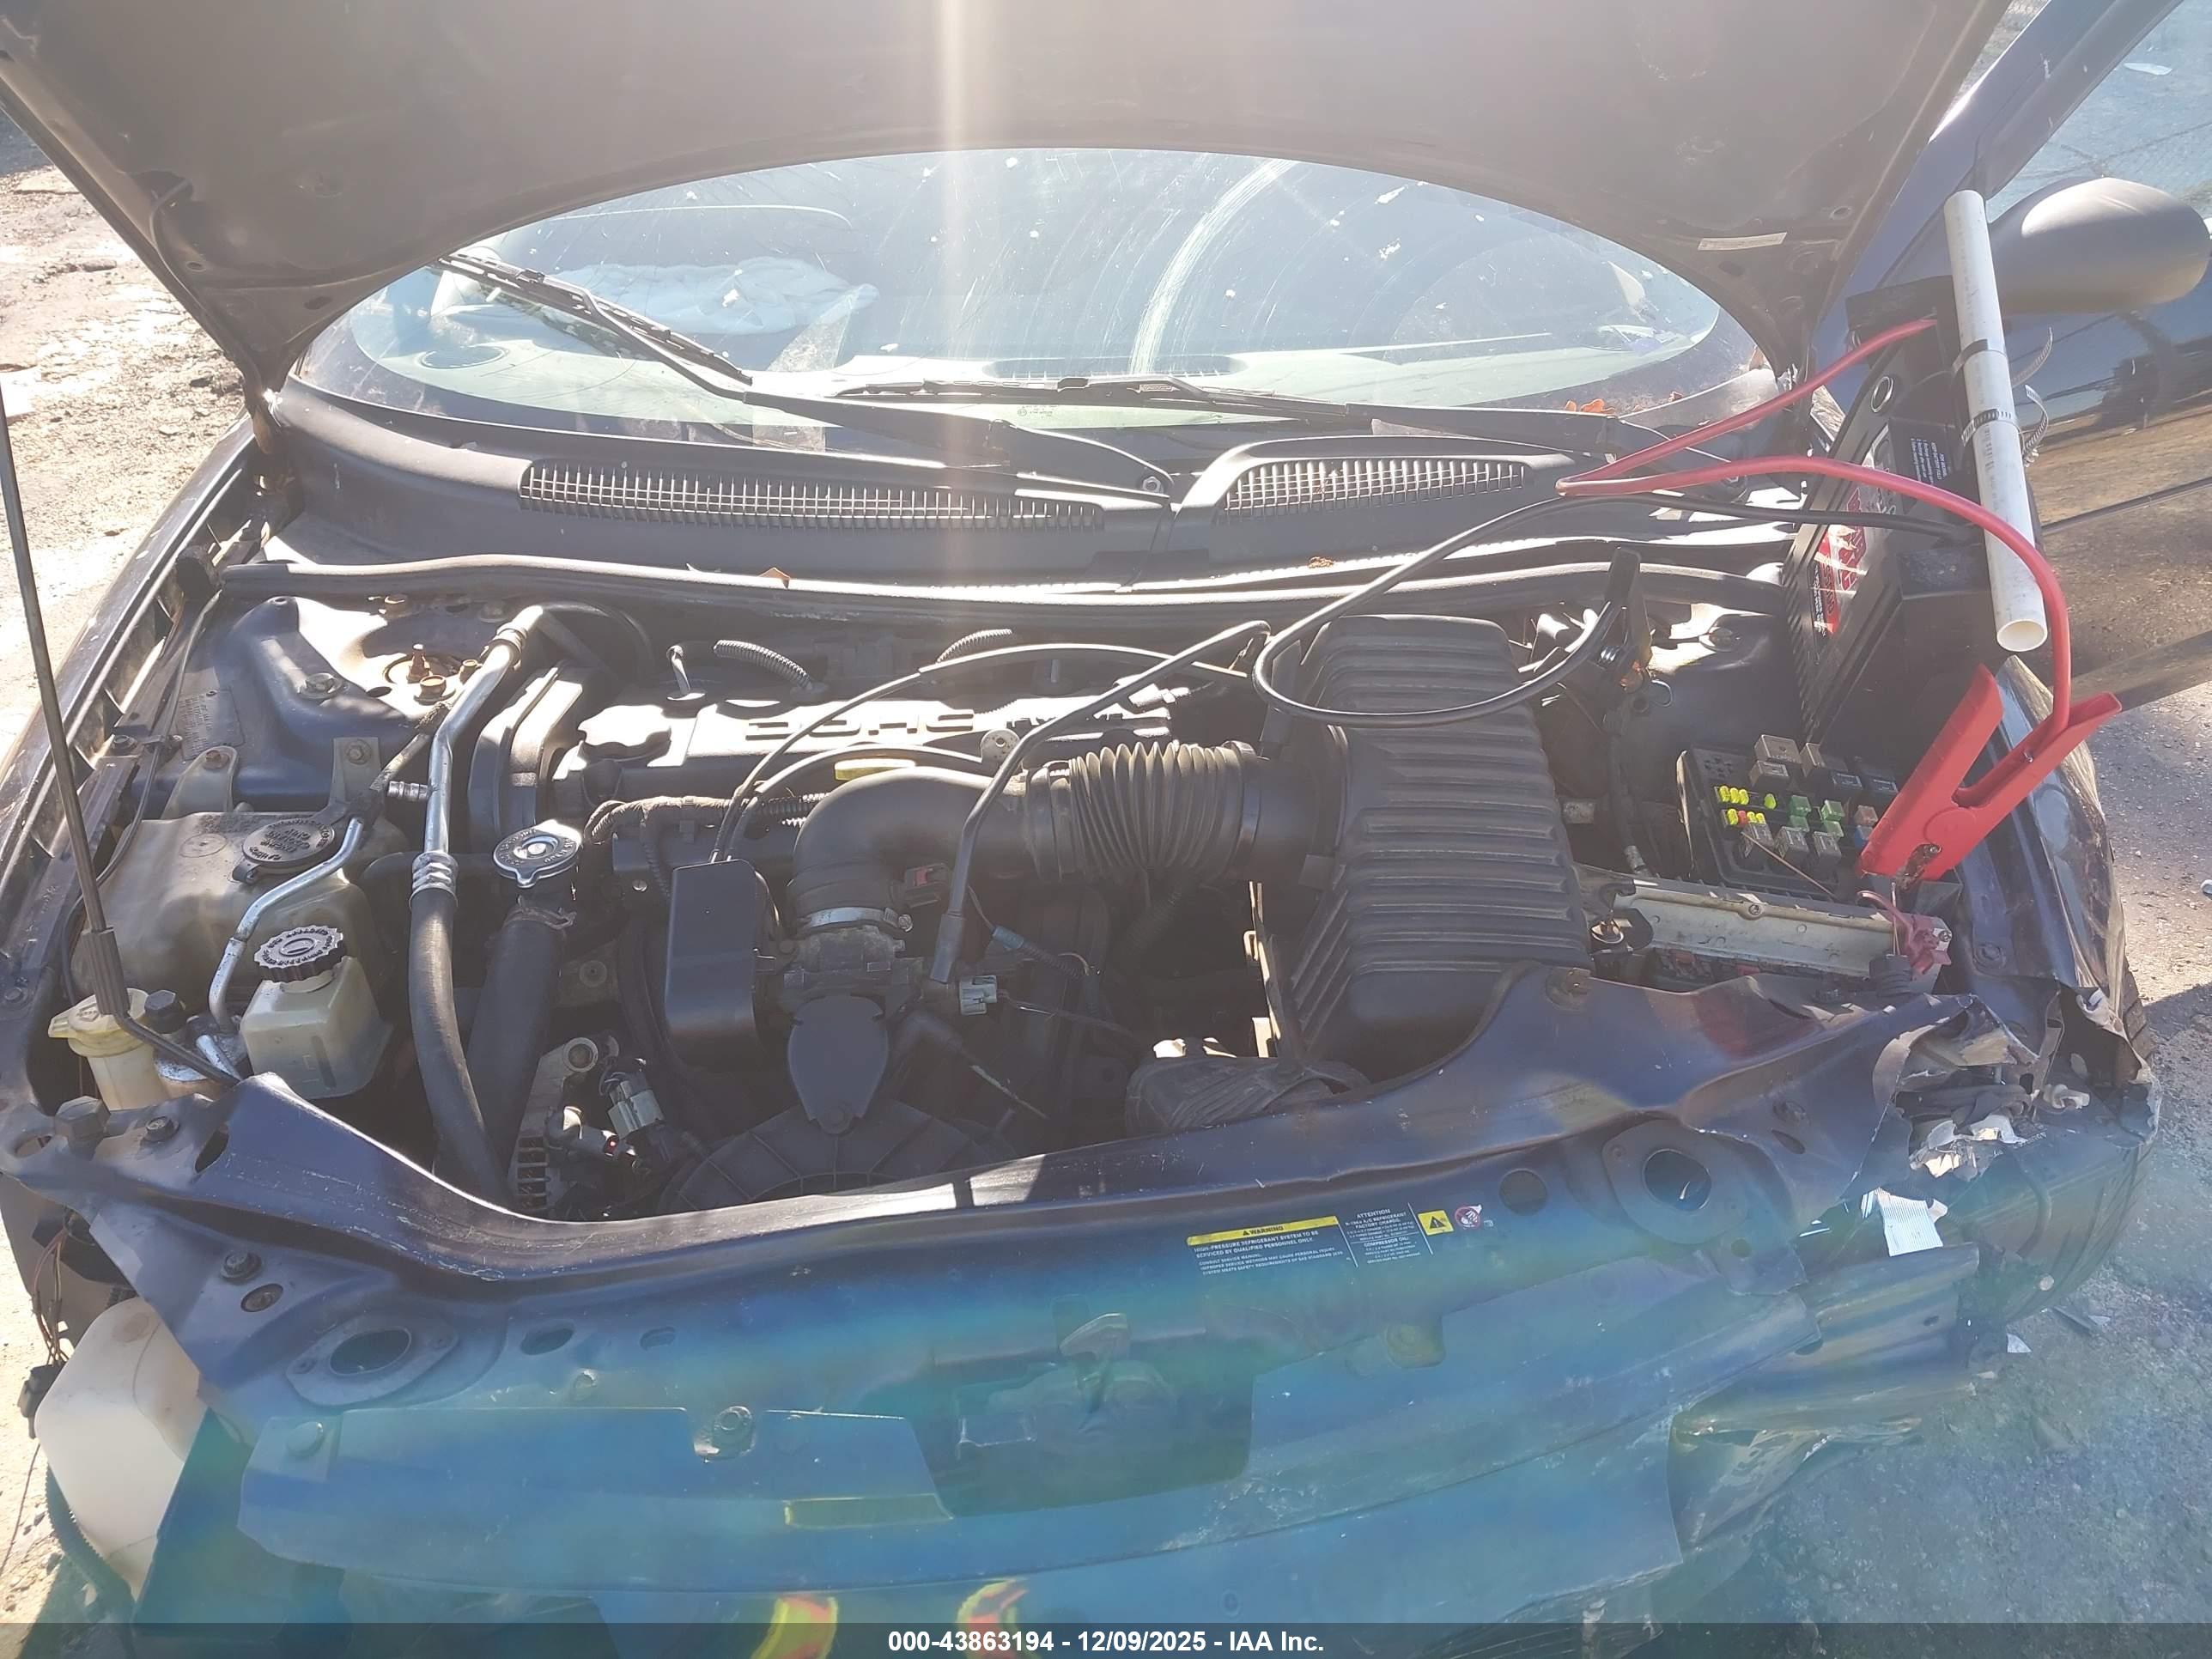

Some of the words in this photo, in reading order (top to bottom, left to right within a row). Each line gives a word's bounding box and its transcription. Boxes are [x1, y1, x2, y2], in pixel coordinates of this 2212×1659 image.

[1357, 1208, 1391, 1218] ATTENTION
[1249, 1225, 1284, 1235] WARNING
[1241, 1236, 1279, 1247] REFRIGERANT
[1279, 1232, 1302, 1241] SYSTEM
[1364, 1238, 1398, 1247] COMPRESSOR
[1196, 1249, 1224, 1259] SERVICED
[1233, 1245, 1263, 1254] QUALIFIED
[1264, 1240, 1297, 1249] PERSONNEL
